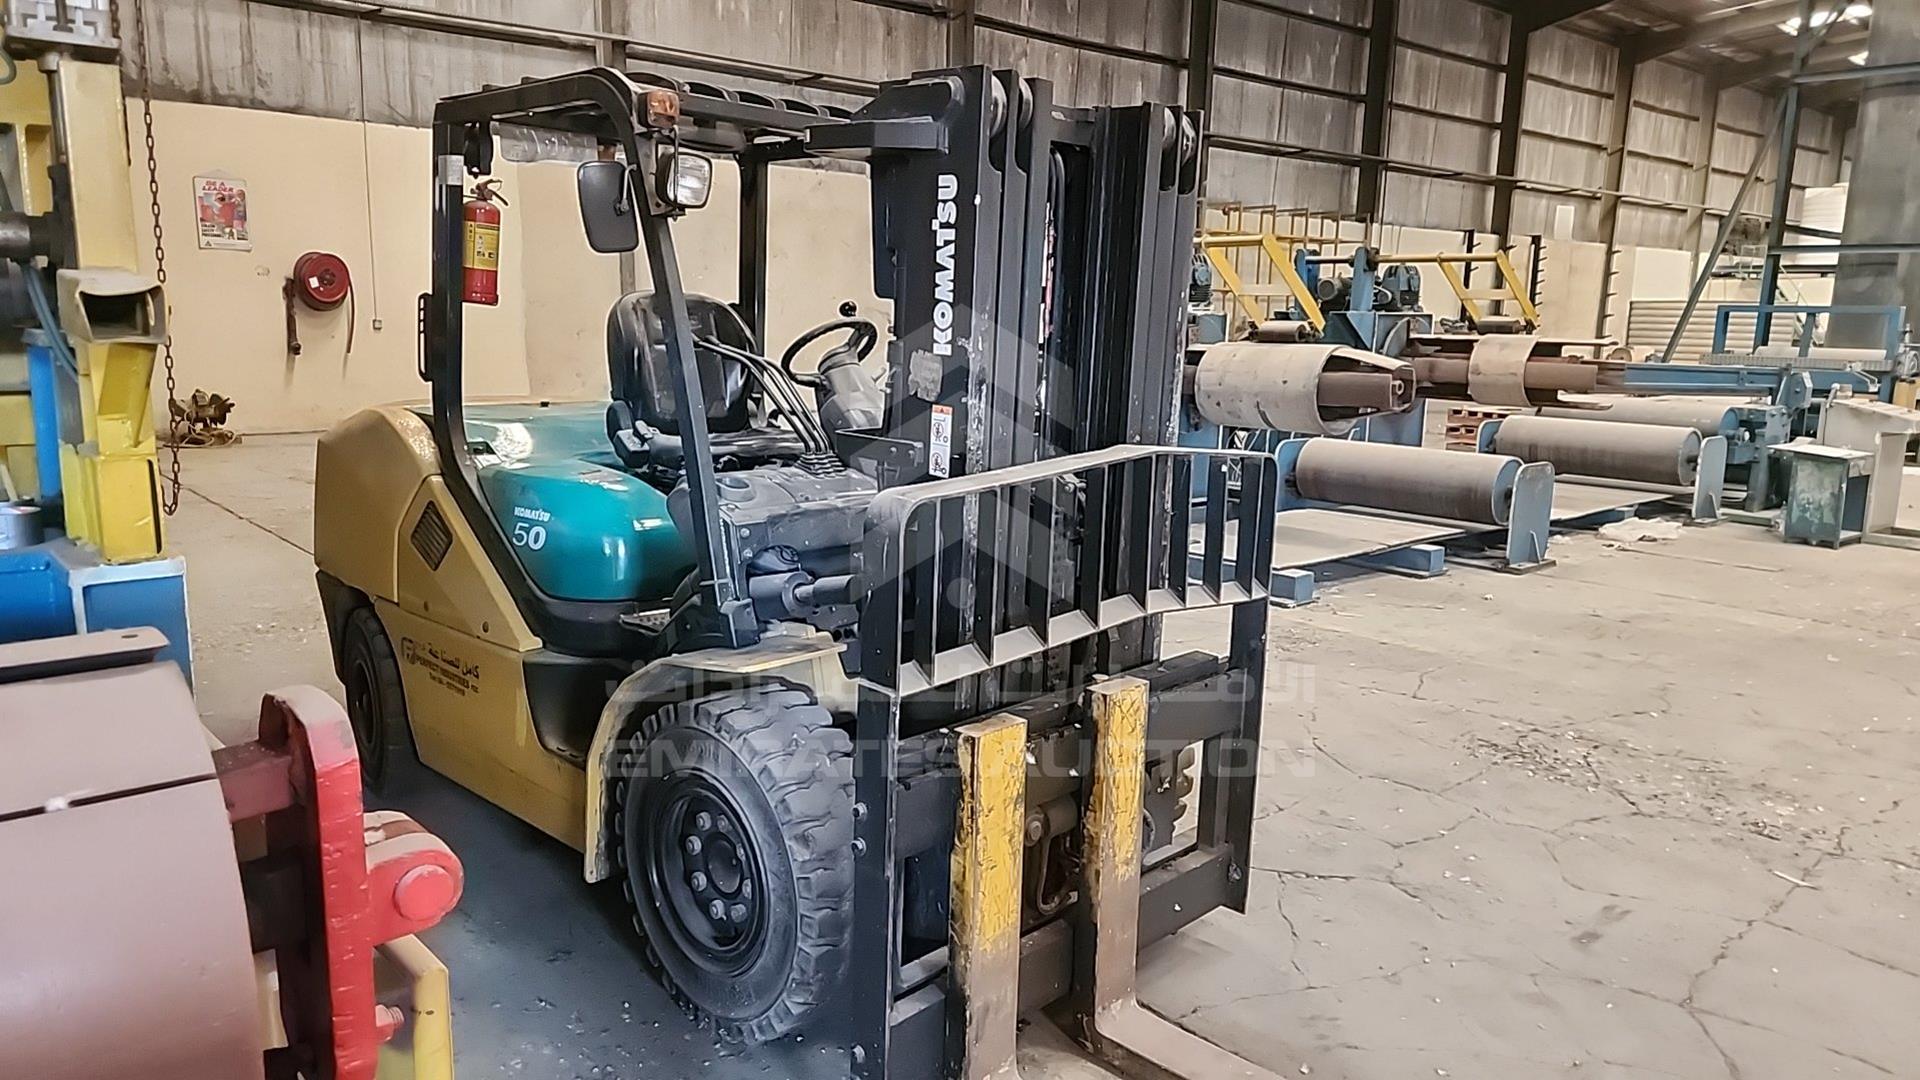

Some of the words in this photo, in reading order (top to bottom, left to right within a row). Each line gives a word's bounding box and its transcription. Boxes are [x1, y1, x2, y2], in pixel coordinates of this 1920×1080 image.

[932, 174, 959, 356] KOMATSU
[514, 506, 551, 522] KOMATSU
[512, 522, 547, 550] 50
